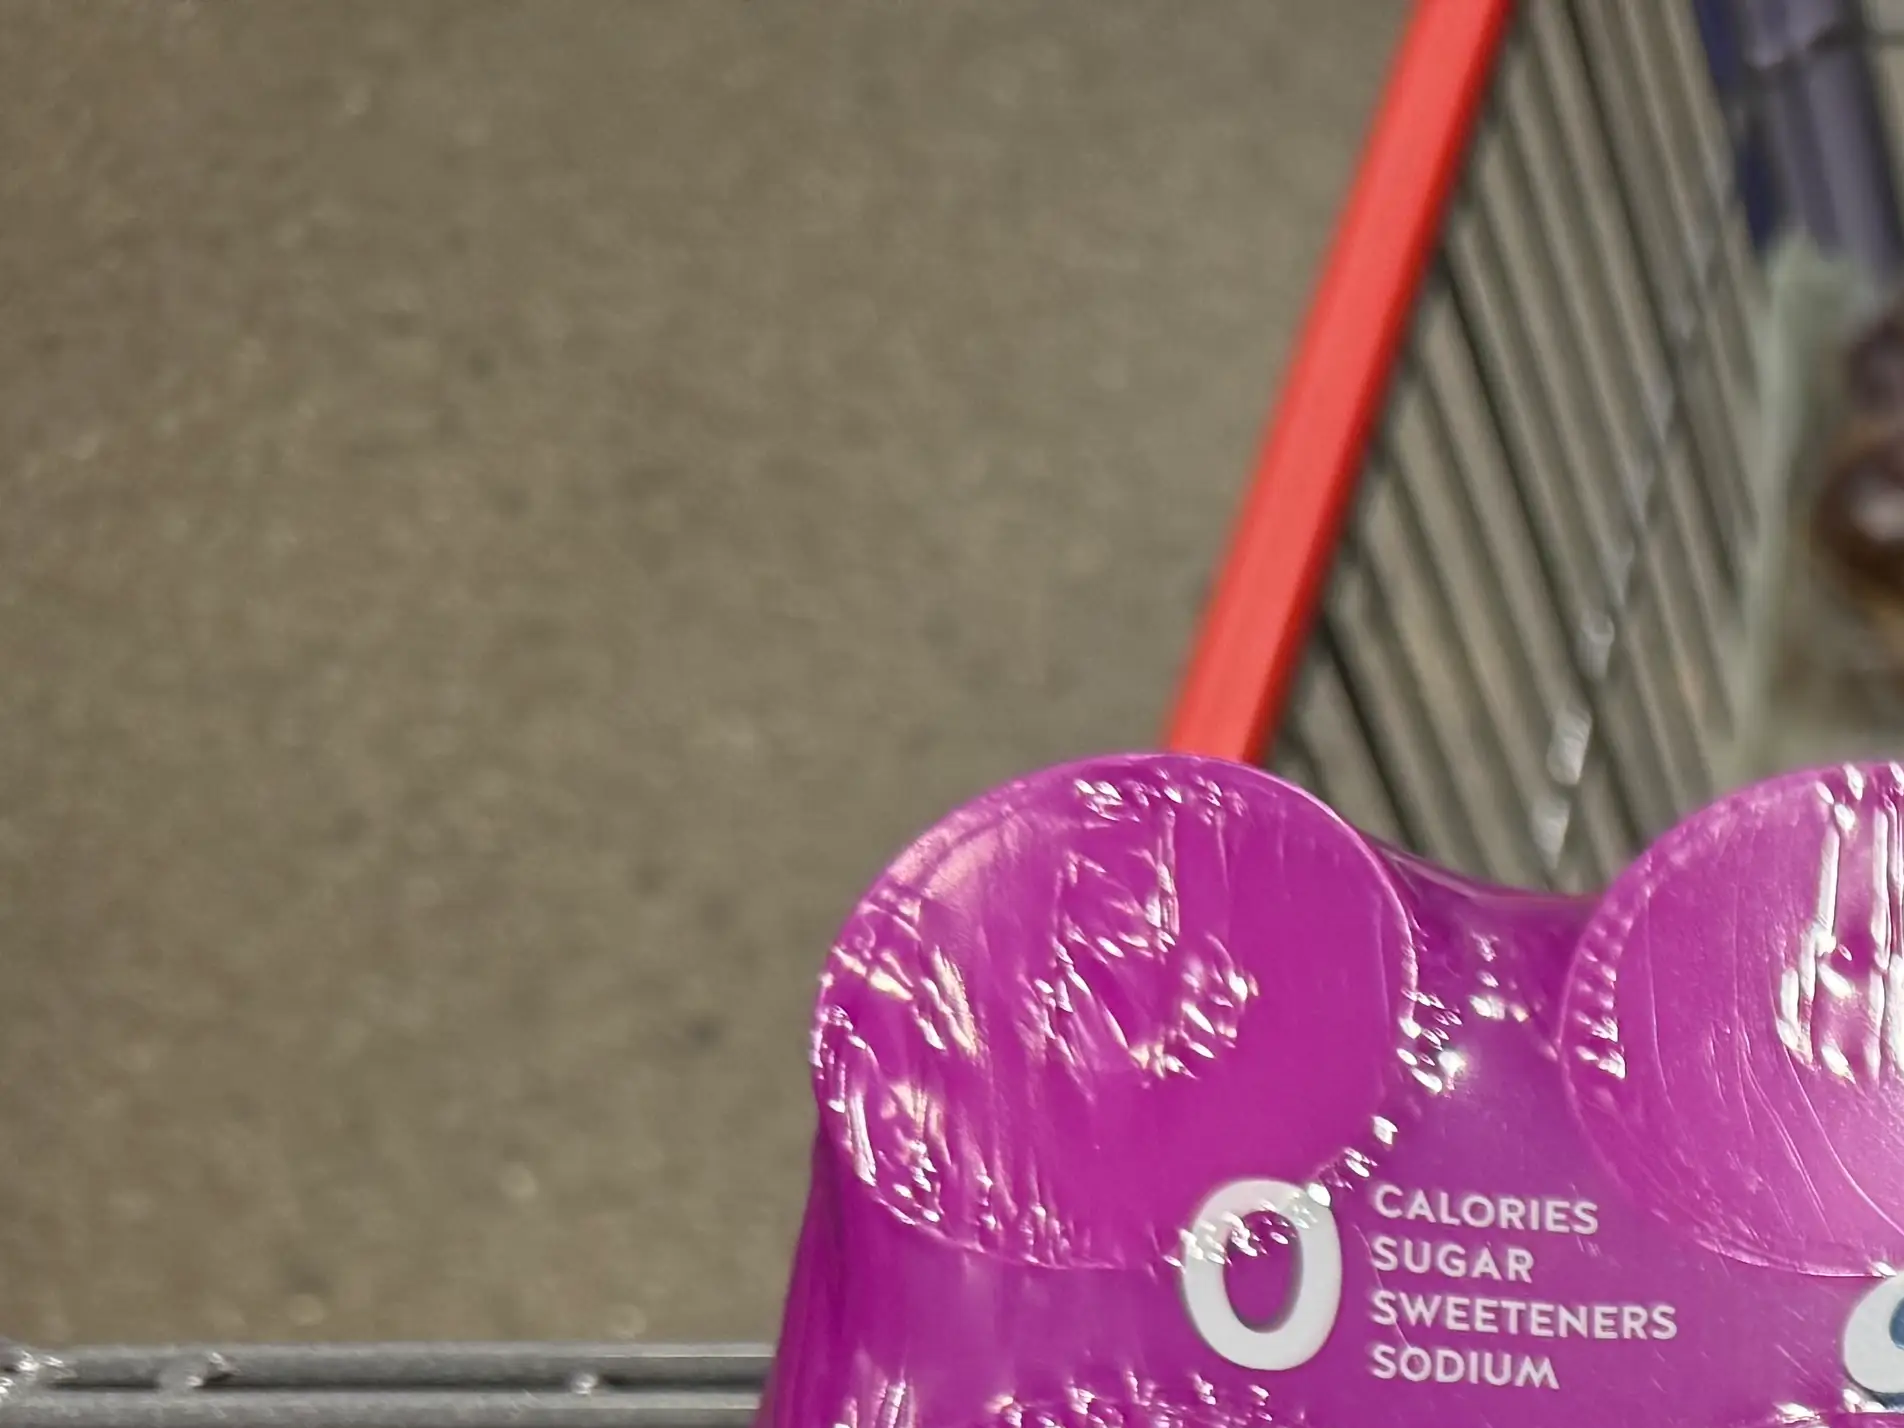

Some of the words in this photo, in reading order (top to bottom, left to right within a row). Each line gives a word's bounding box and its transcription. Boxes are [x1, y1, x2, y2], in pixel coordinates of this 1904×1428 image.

[1373, 1184, 1600, 1236] CALORIES
[1181, 1179, 1343, 1371] 0
[1373, 1237, 1534, 1283] SUGAR
[1373, 1291, 1678, 1342] SWEETENERS
[1373, 1344, 1560, 1391] SODIUM
